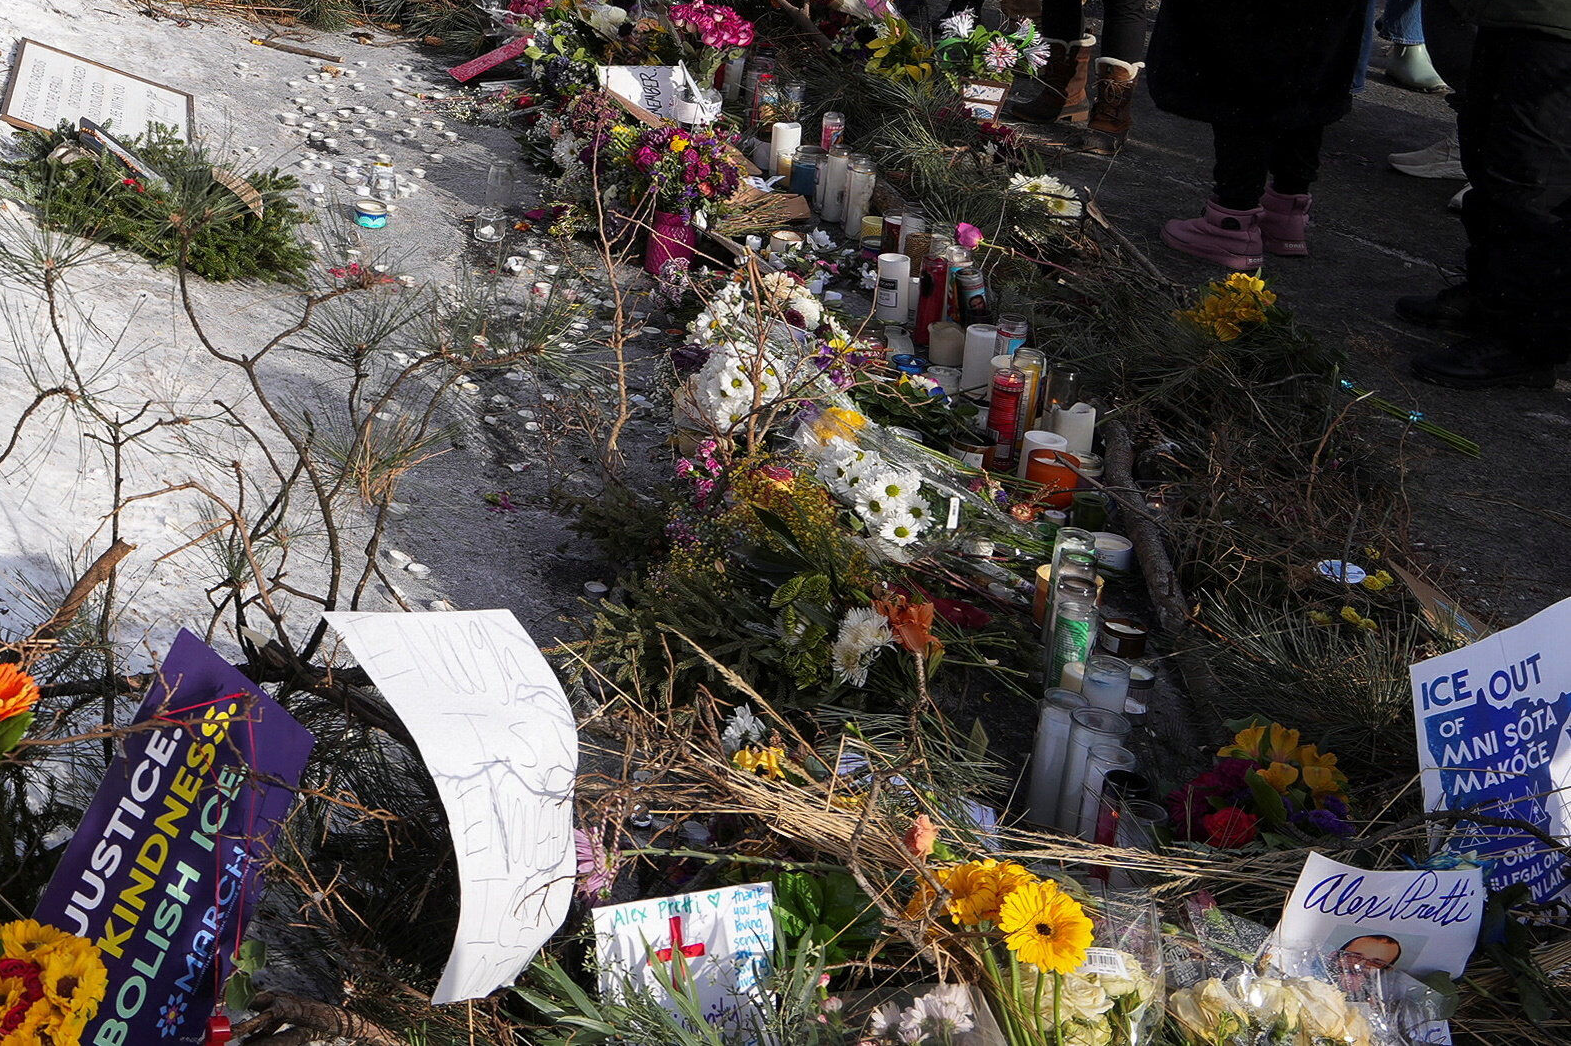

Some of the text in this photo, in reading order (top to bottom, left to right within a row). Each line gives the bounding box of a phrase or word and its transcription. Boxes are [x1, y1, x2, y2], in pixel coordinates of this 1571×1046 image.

[1421, 653, 1542, 711] ICE OUT
[1439, 716, 1465, 738] OF
[1442, 705, 1558, 767] MNI SÓTA
[1453, 740, 1550, 795] MAKÓČE
[64, 727, 183, 938] JUSTICE.
[96, 702, 237, 959] KINDNESS.
[1504, 840, 1536, 867] ONE
[174, 845, 246, 993] MARCH
[614, 894, 702, 928] Alex Pretti
[734, 902, 770, 917] you for
[1303, 870, 1475, 927] Alex Pretti
[93, 860, 201, 1046] BOLISH
